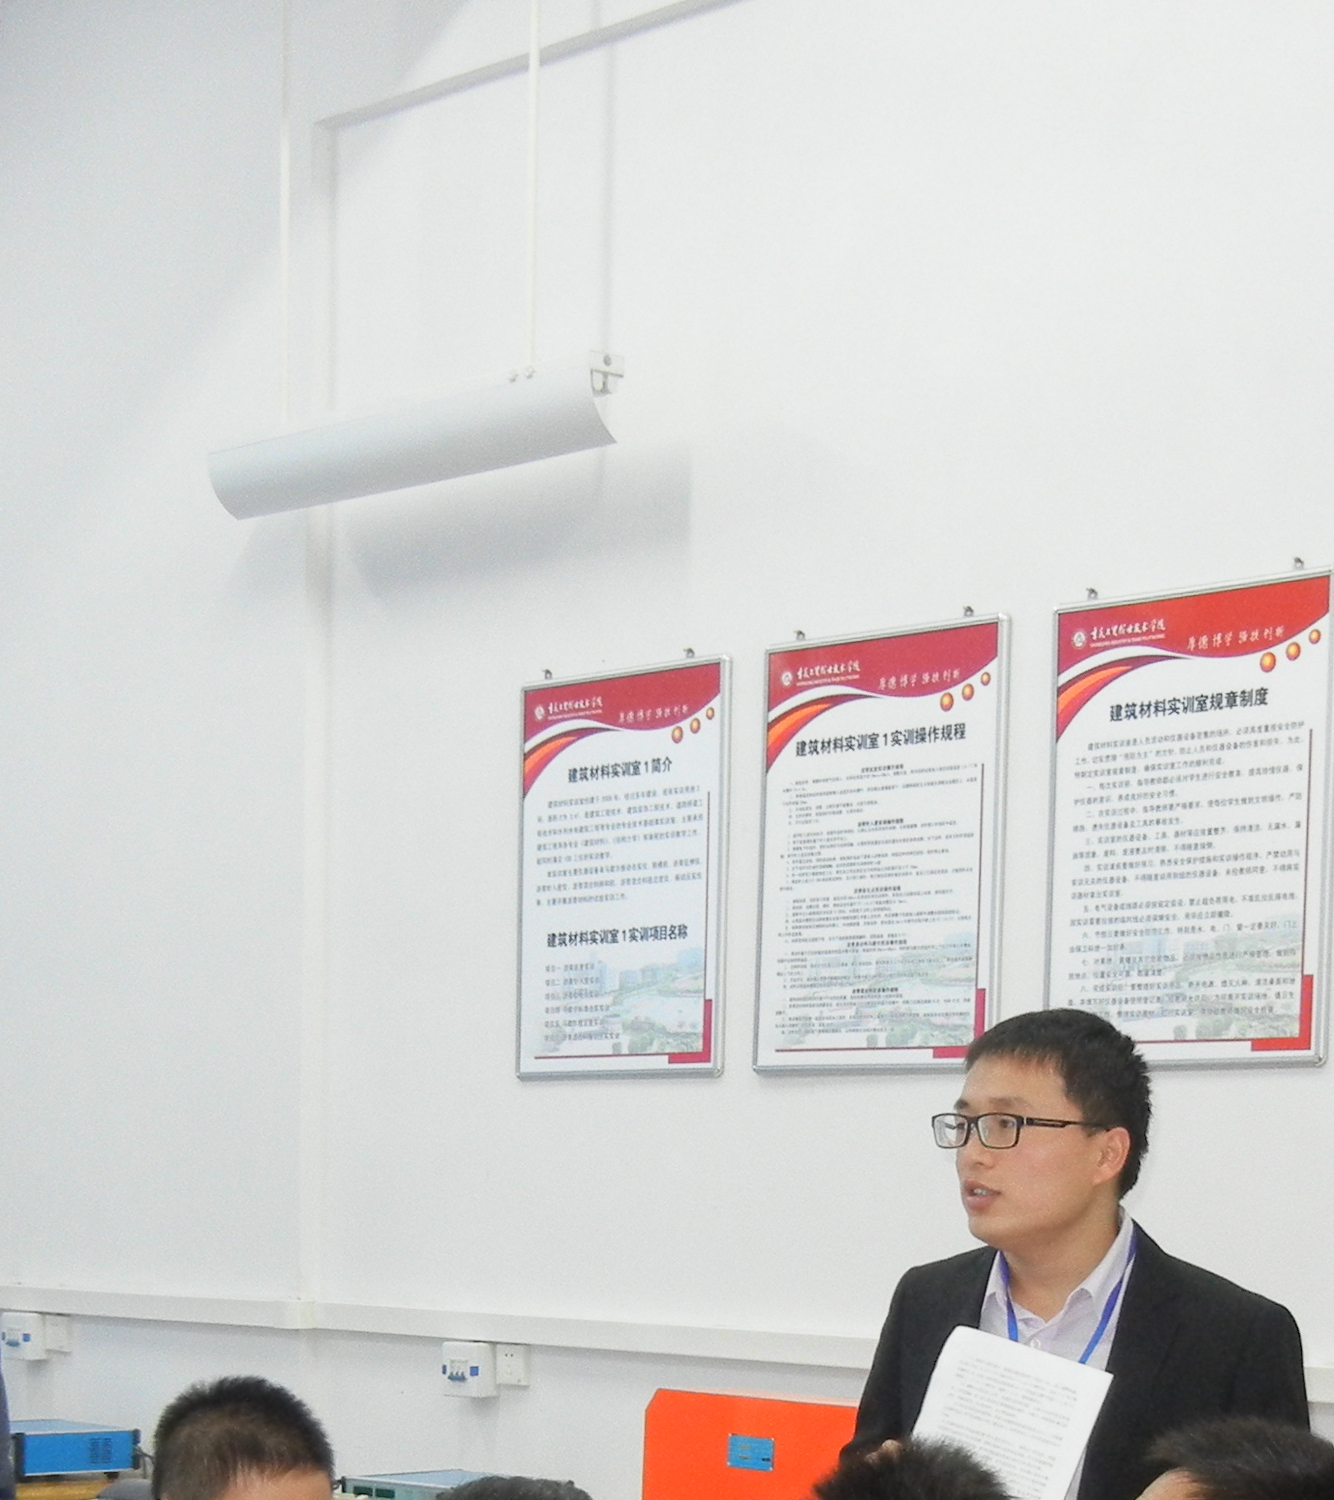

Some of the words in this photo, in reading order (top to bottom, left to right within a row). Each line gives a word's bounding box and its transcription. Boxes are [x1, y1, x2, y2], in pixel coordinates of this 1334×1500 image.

[1109, 686, 1269, 723] 建筑材料实训室规章制度
